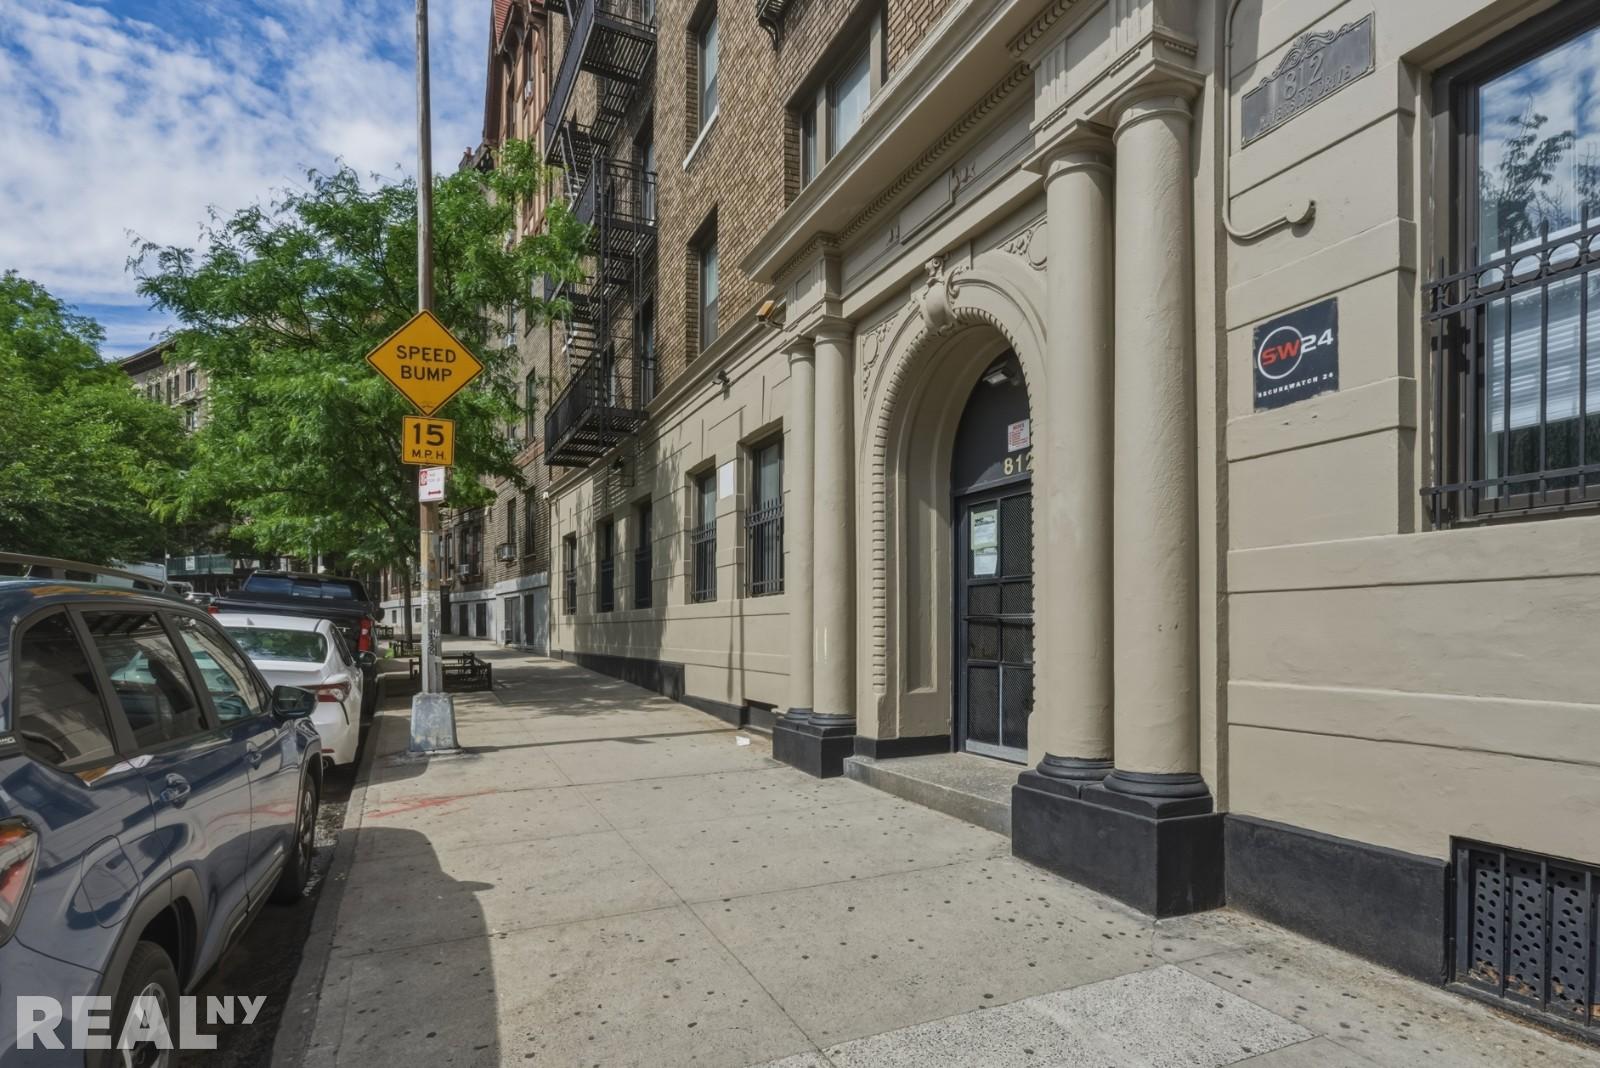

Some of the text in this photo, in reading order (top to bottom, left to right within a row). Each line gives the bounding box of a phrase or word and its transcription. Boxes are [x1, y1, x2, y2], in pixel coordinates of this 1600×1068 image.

[1283, 50, 1323, 101] 812
[396, 345, 456, 363] SPEED
[401, 365, 453, 382] BUMP
[413, 423, 444, 446] 15
[1004, 452, 1032, 475] 812
